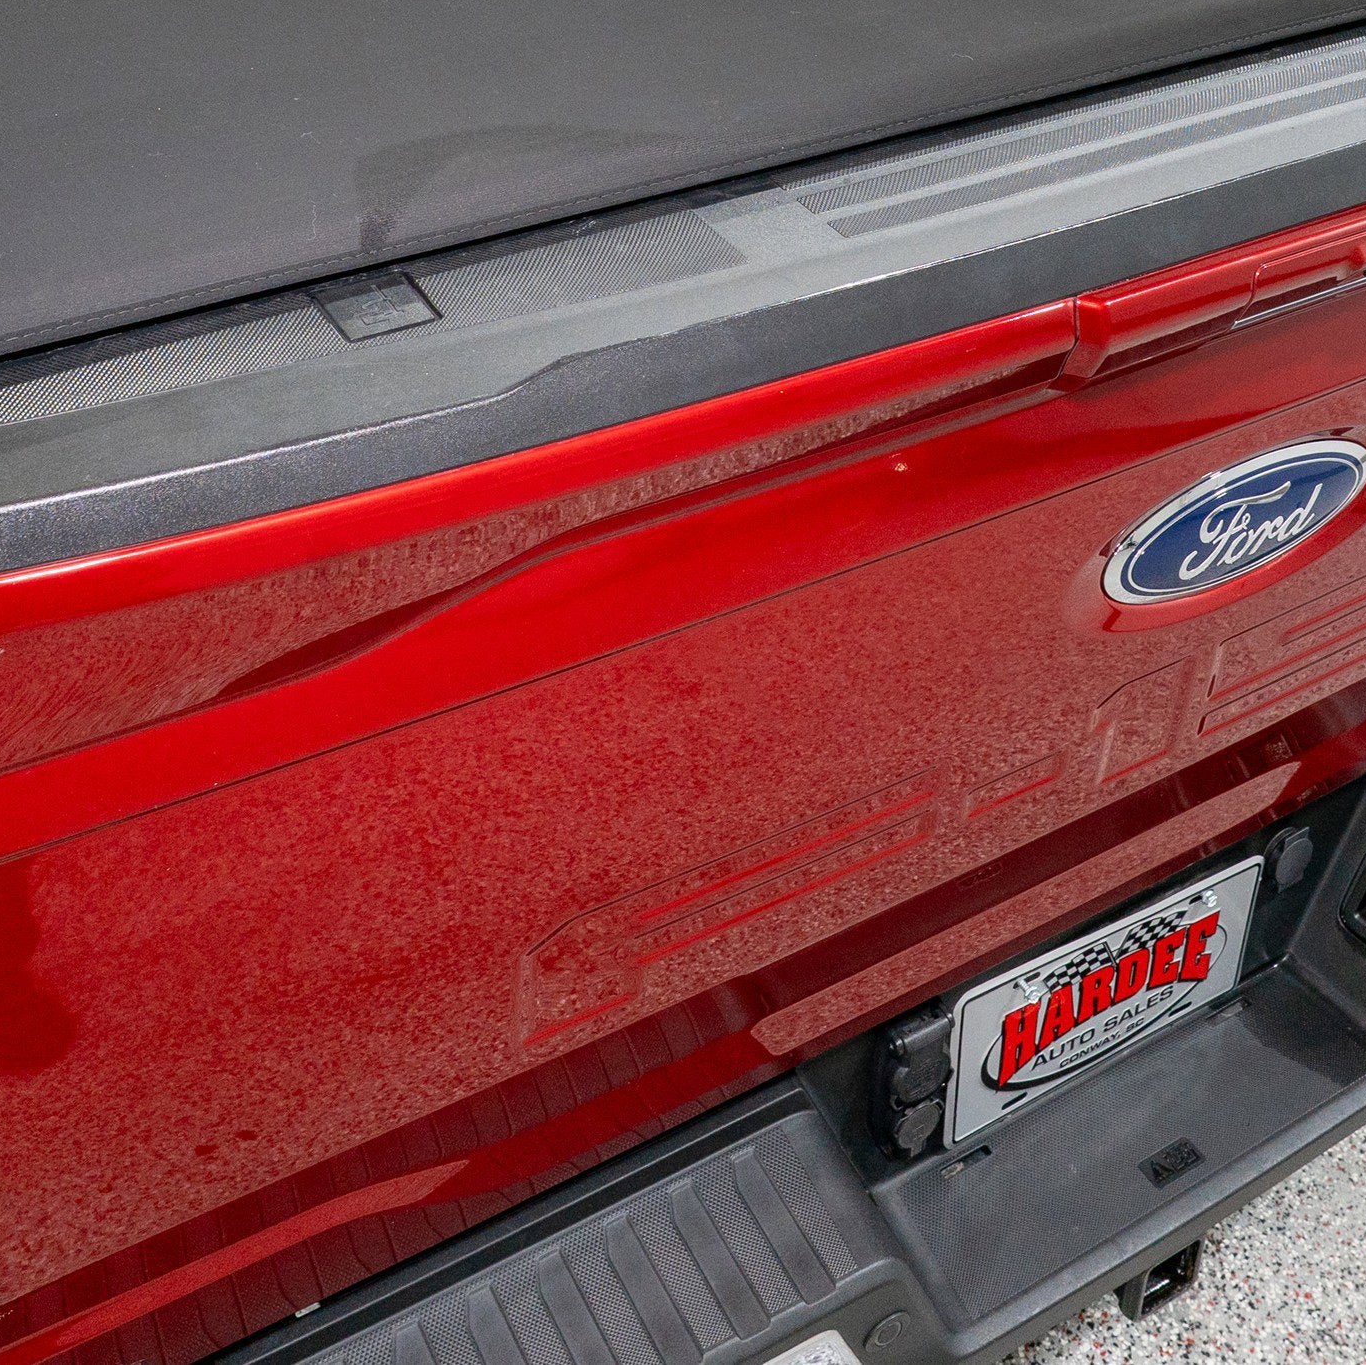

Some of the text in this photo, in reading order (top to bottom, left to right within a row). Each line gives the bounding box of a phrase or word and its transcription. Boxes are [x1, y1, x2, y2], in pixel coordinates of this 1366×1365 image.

[1178, 481, 1324, 580] Ford
[997, 910, 1220, 1087] HARDEE
[1031, 985, 1174, 1071] AUTO SALES
[1059, 1017, 1145, 1068] CONWAY, SC
